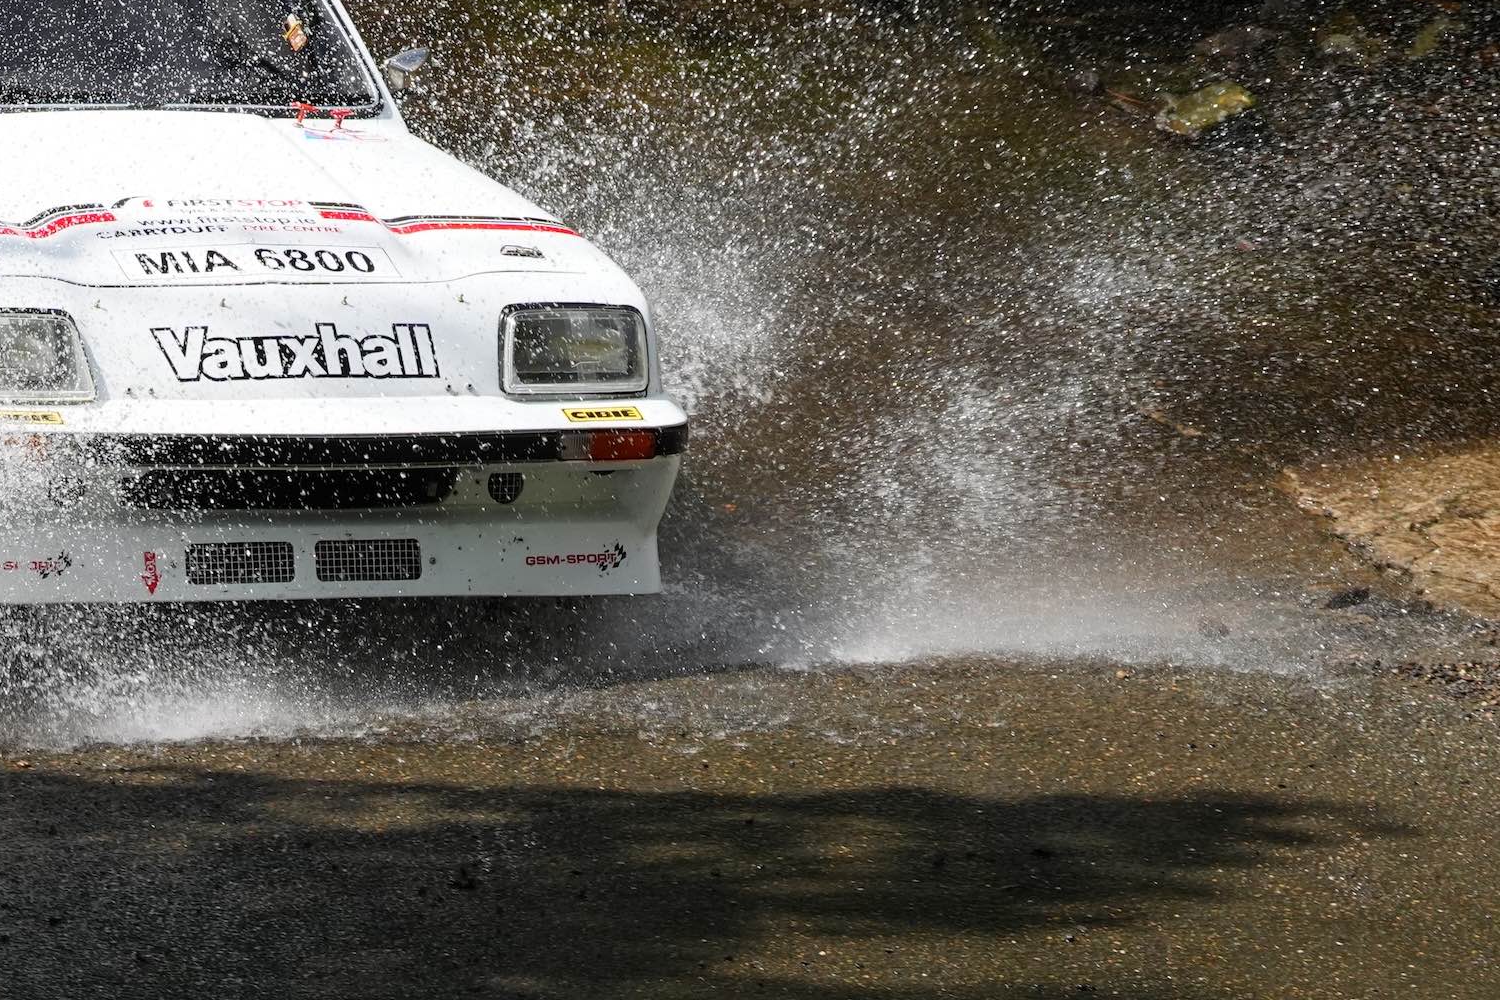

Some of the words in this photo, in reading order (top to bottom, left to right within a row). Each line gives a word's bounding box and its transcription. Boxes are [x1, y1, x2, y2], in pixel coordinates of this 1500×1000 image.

[96, 225, 228, 240] CARRYDUFF
[242, 225, 278, 233] TYRE
[282, 225, 342, 235] CENTRE
[134, 250, 242, 275] MIA
[254, 248, 375, 273] 6800
[150, 323, 440, 382] Vauxhall
[570, 410, 638, 419] CIBIE
[525, 553, 617, 567] GSM-SPORT
